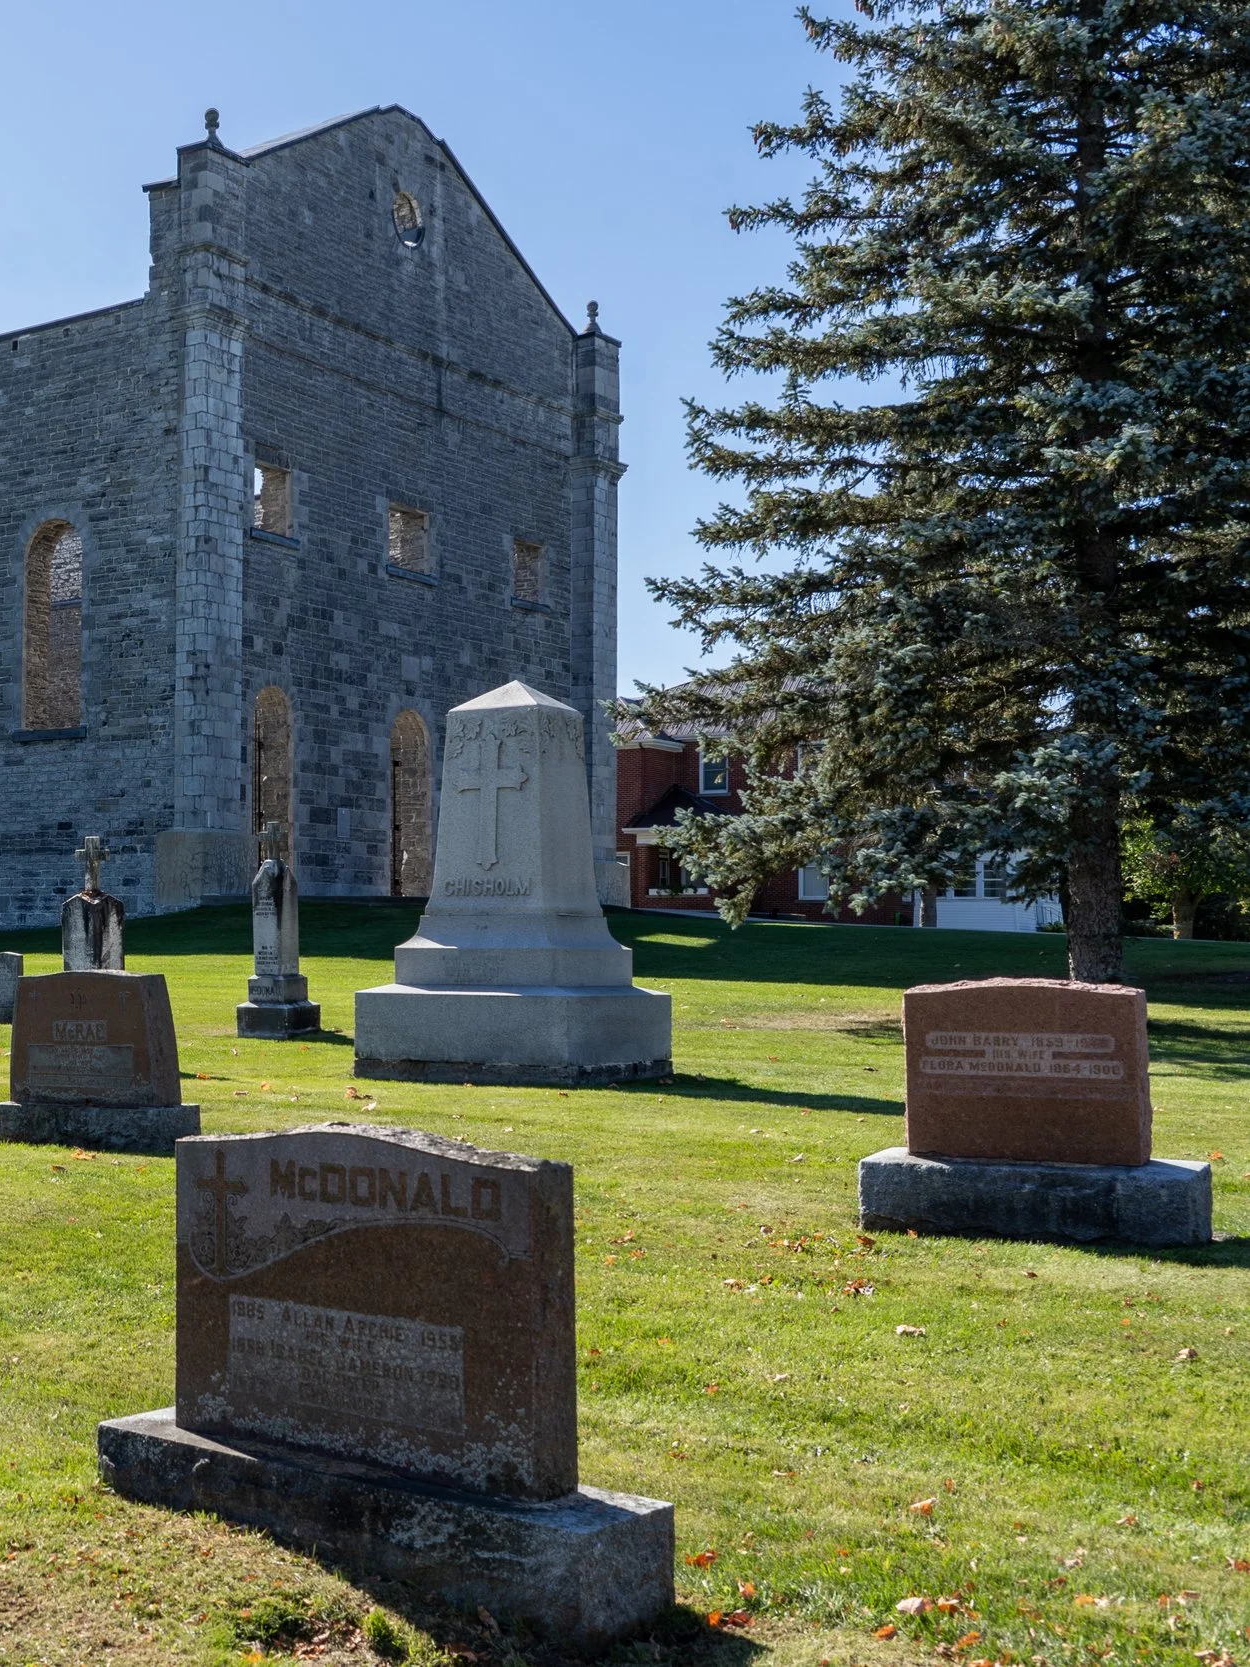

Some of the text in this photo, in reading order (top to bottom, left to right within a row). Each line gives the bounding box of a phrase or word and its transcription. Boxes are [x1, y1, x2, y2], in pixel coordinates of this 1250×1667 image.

[444, 876, 532, 897] CHISHOLM
[54, 1021, 106, 1042] McRAE
[930, 1035, 967, 1047] JOHN
[973, 1035, 1019, 1047] BARRY
[992, 1049, 1046, 1061] HIS WIFE
[922, 1059, 964, 1072] FLORA
[969, 1060, 1041, 1074] McDONALD
[269, 1157, 503, 1222] McDONALD
[280, 1303, 336, 1331] ALLAN
[343, 1315, 406, 1344] ARCHIE
[420, 1330, 462, 1353] 1955
[269, 1338, 329, 1369] ISABEL
[334, 1355, 416, 1384] CAMERON
